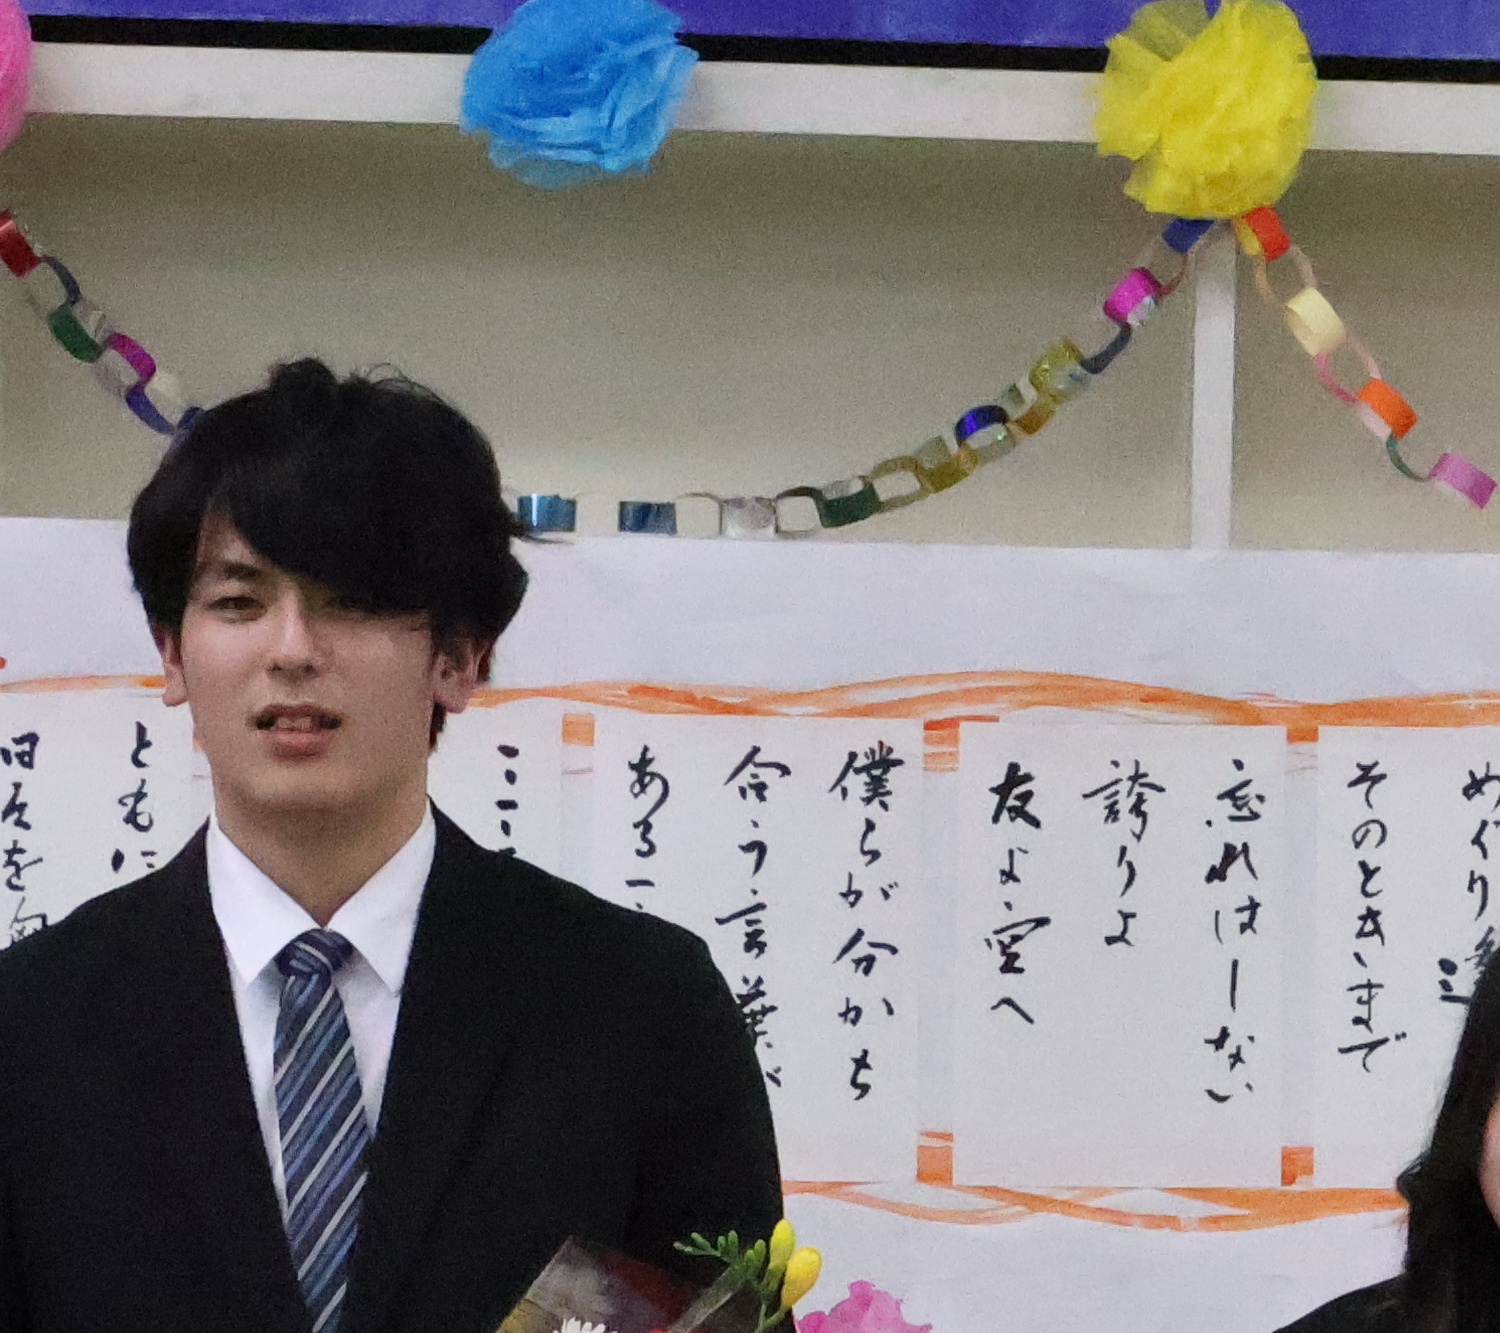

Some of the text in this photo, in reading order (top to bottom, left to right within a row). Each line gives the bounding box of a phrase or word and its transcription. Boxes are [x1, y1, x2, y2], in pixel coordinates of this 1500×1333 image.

[828, 740, 904, 1100] 僕らが分かち
[984, 762, 1051, 1024] 友よ空へ
[1082, 760, 1166, 947] 誇りよ
[1204, 759, 1265, 1103] 忘れはしない
